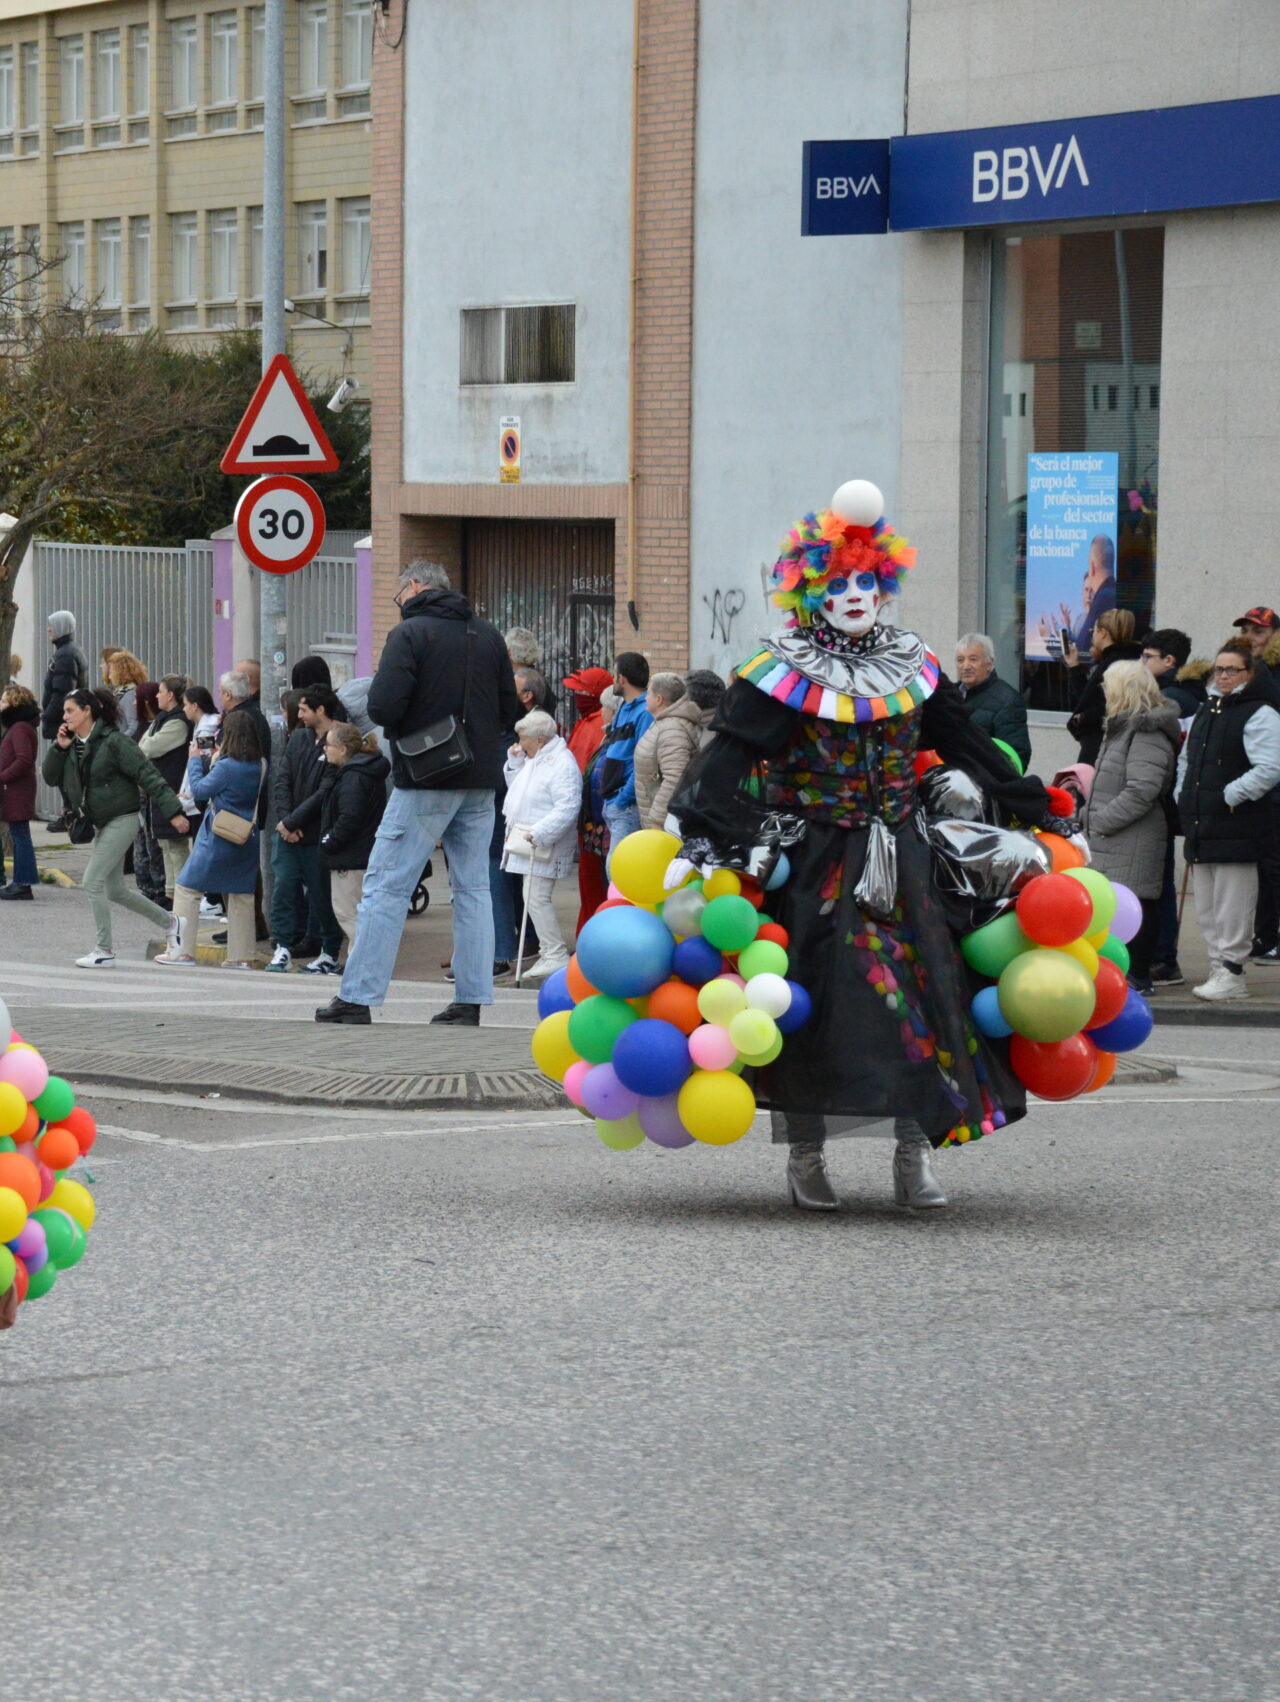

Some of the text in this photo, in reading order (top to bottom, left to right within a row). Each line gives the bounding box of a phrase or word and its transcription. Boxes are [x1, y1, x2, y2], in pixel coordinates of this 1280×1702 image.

[972, 134, 1090, 203] BBVA
[816, 174, 881, 199] BBVA
[1060, 455, 1070, 471] el
[1072, 456, 1104, 474] mejor
[1031, 477, 1062, 492] grupo
[1064, 473, 1077, 488] de
[1043, 489, 1116, 509] profesionales
[258, 508, 304, 540] 30
[1064, 508, 1080, 523] del
[1081, 509, 1115, 523] sector
[1029, 524, 1087, 540] de la banca
